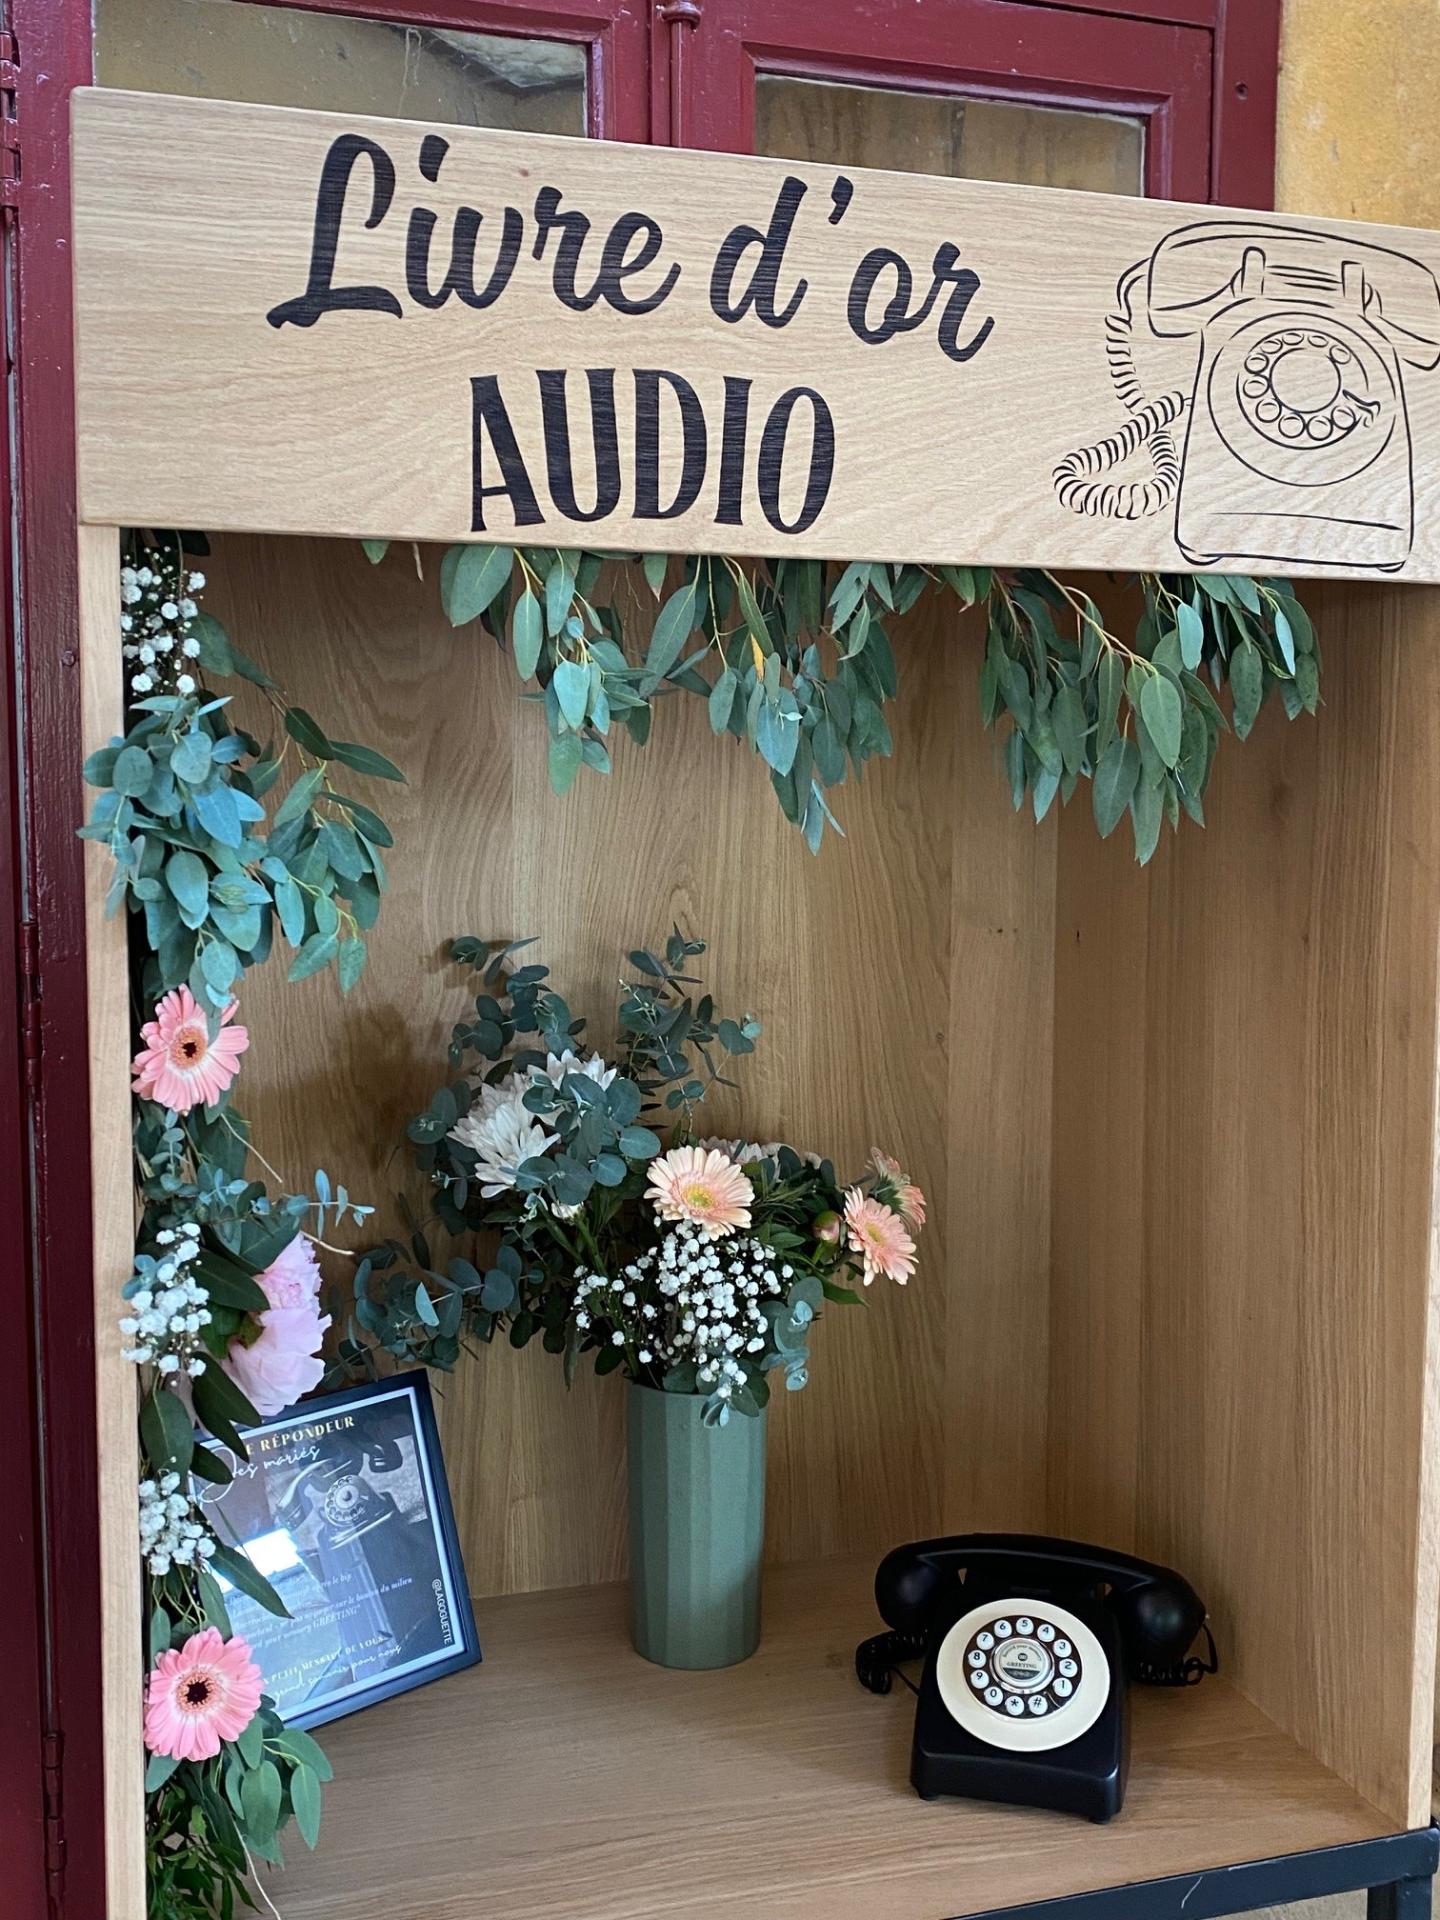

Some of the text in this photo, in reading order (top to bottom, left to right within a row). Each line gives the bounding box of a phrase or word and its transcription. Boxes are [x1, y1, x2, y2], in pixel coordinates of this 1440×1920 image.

[266, 134, 995, 362] Livre d'or
[469, 368, 835, 535] AUDIO
[260, 1416, 355, 1452] RÉPONDEUR
[999, 1622, 1007, 1631] 6
[1021, 1619, 1029, 1628] 5
[1042, 1625, 1050, 1635] 4
[982, 1633, 989, 1642] 7
[1059, 1641, 1067, 1650] 3
[973, 1651, 981, 1661] 8
[1064, 1661, 1073, 1670] 2
[976, 1671, 984, 1680] 9
[1061, 1679, 1066, 1689] 1
[990, 1688, 998, 1698] 0
